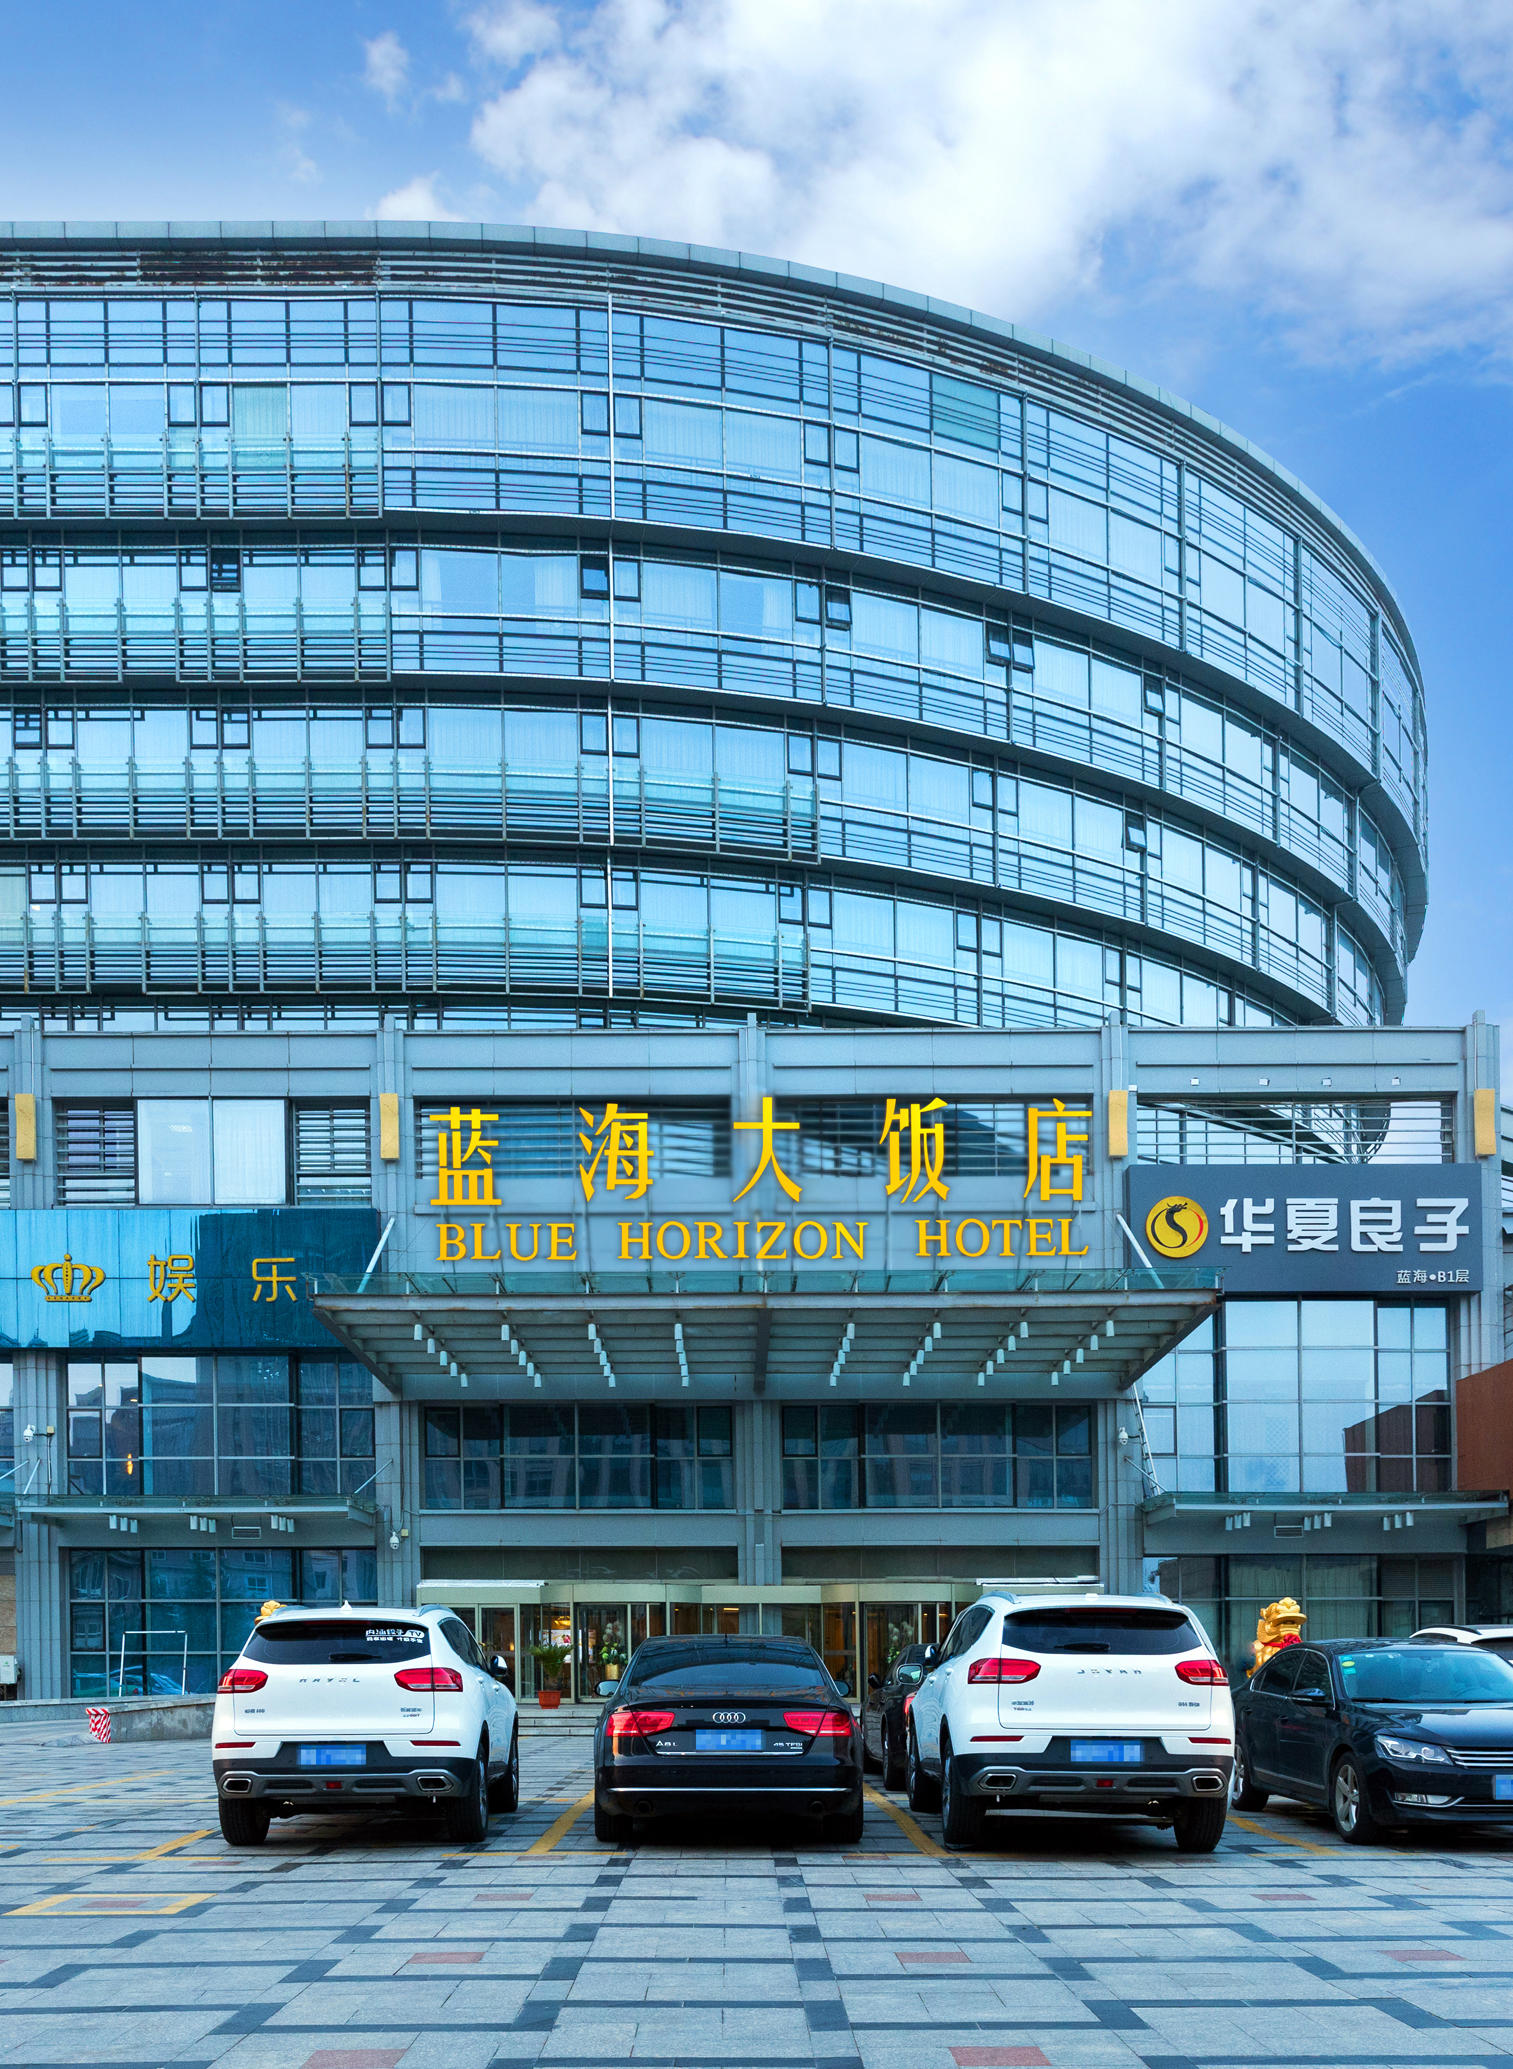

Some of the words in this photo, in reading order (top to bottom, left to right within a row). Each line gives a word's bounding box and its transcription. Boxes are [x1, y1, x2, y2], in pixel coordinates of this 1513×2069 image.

[429, 1097, 1092, 1206] 蓝海大饭店
[435, 1222, 577, 1261] BLUE
[617, 1220, 868, 1260] HORIZON
[914, 1217, 1088, 1257] HOTEL
[1220, 1197, 1470, 1253] 华夏良子
[147, 1254, 297, 1303] 娱乐
